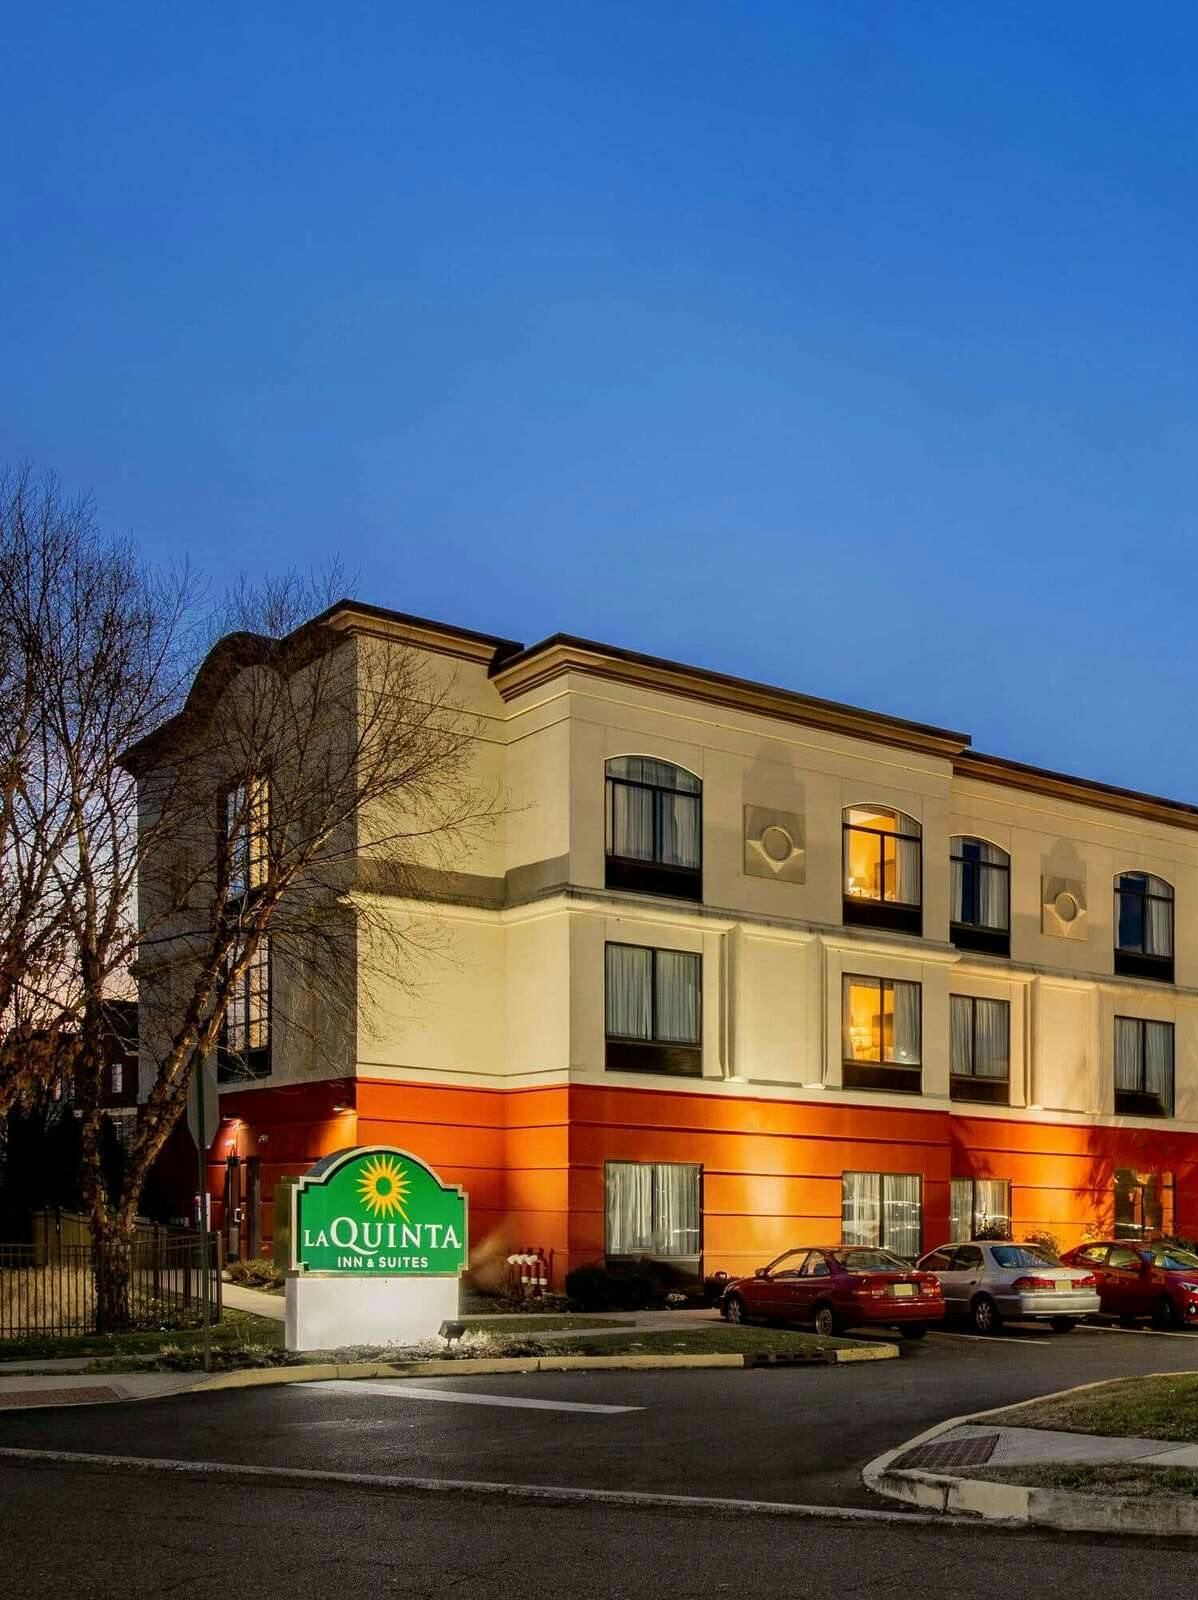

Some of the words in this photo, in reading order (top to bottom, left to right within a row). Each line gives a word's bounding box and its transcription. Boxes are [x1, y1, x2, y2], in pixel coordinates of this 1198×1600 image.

[303, 1229, 329, 1247] LA
[329, 1216, 461, 1255] QUINTA
[337, 1256, 363, 1268] INN
[366, 1258, 375, 1268] &
[378, 1256, 429, 1268] SUITES
